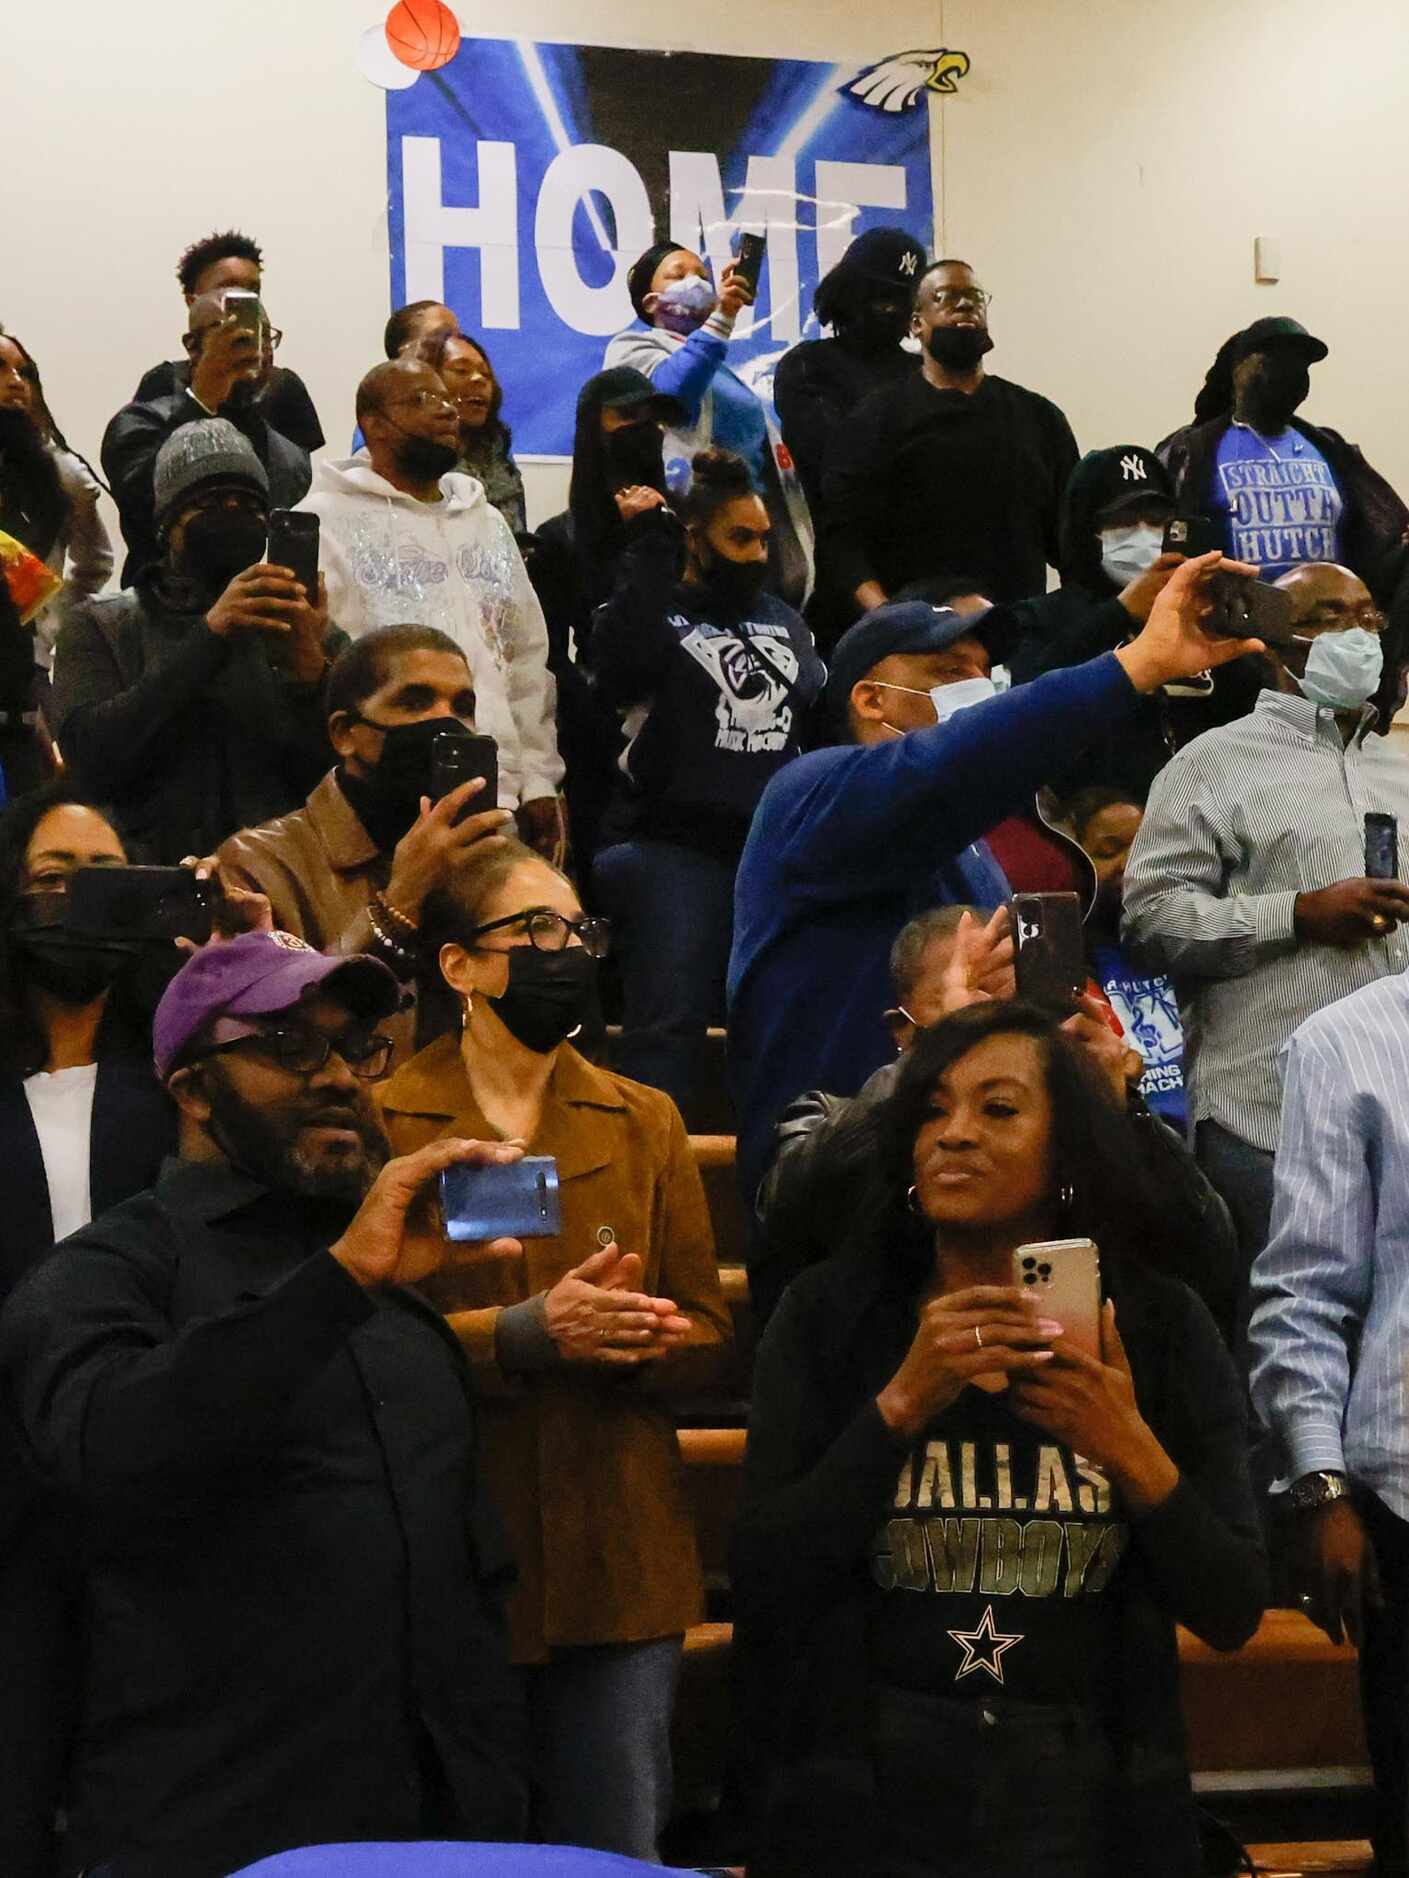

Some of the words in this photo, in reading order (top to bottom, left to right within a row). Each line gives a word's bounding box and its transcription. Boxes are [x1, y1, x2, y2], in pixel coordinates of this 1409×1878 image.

[898, 251, 918, 275] NY
[1120, 454, 1147, 480] NY
[1227, 462, 1329, 487] STRAIGHT
